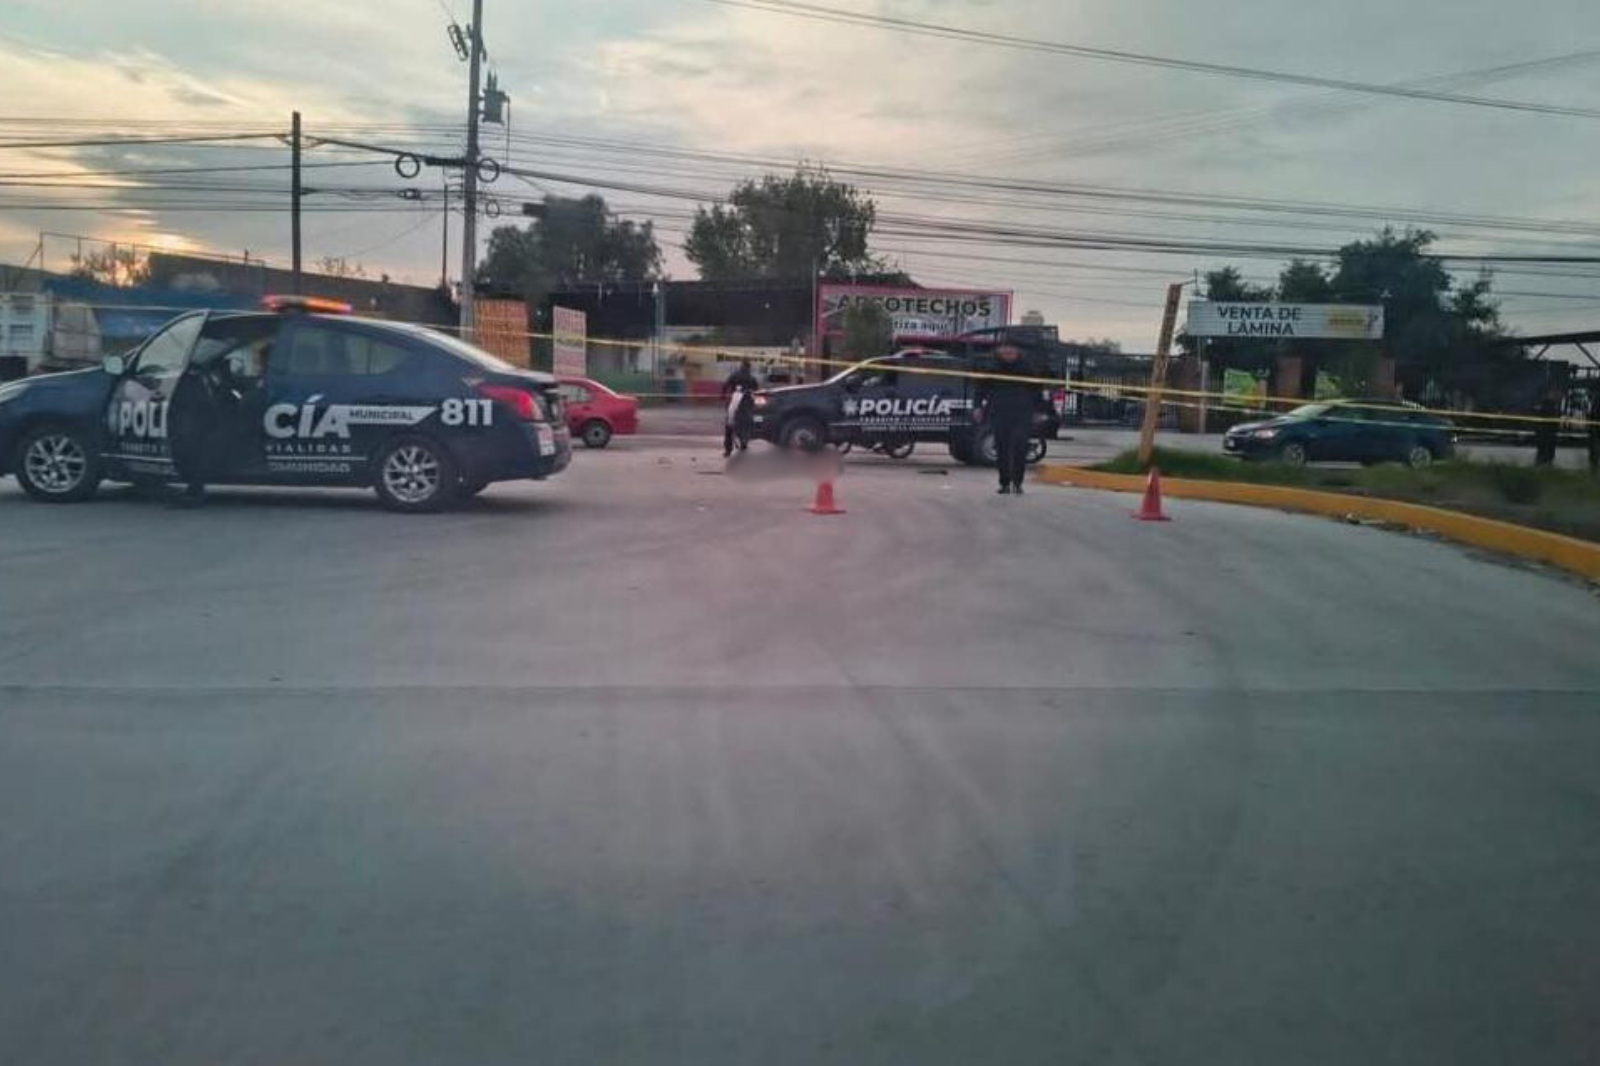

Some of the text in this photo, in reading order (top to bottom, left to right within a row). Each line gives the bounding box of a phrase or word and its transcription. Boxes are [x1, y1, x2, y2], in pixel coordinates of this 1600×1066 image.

[1217, 305, 1303, 321] VENTA DE
[263, 394, 351, 439] CÍA
[349, 408, 413, 420] MUNICIPAL
[441, 398, 493, 426] 811
[859, 394, 952, 416] POLICÍA
[119, 399, 169, 438] POLI
